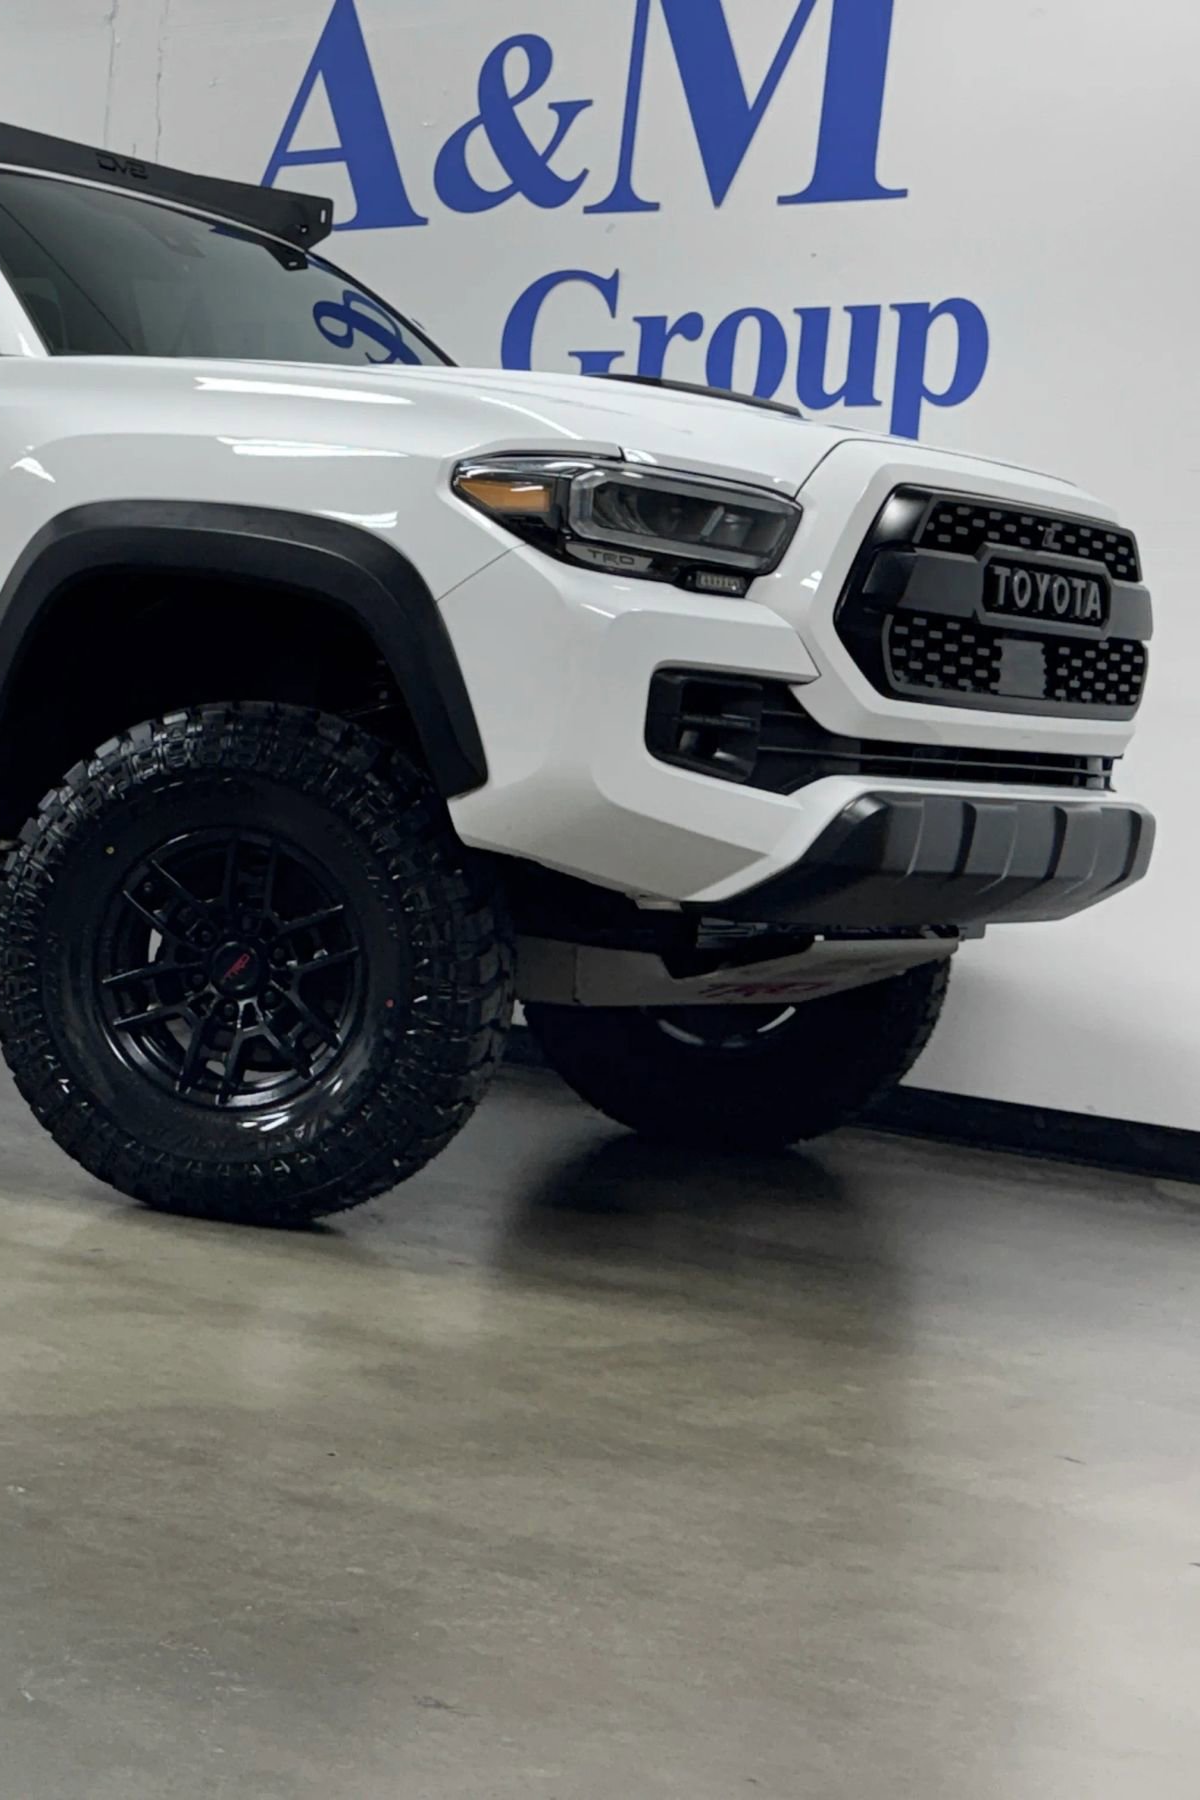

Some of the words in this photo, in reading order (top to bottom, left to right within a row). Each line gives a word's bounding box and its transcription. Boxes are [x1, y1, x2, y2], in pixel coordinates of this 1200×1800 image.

[260, 0, 907, 232] A&M
[501, 269, 989, 441] Group
[990, 564, 1101, 620] TOYOTA
